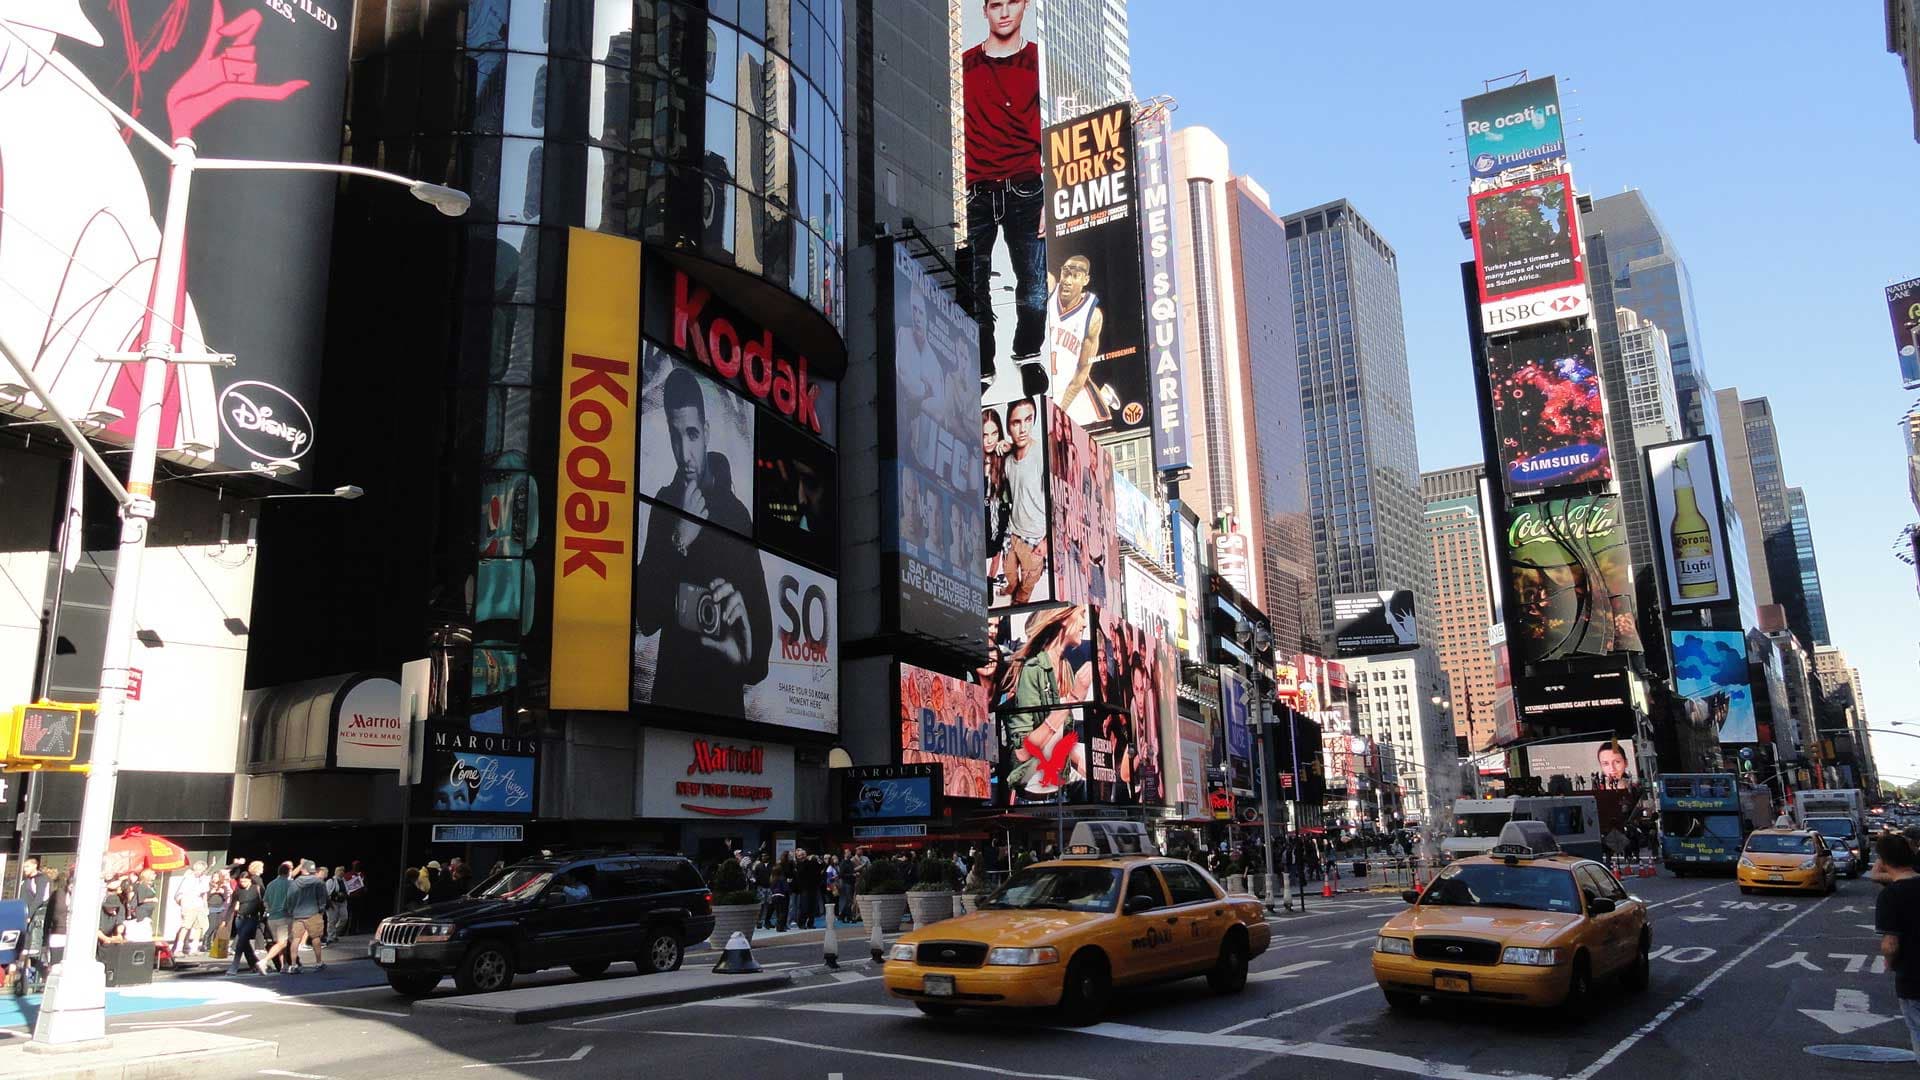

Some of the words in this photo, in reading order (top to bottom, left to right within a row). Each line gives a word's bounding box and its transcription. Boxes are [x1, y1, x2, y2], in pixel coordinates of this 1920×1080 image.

[1050, 109, 1123, 168] NEW
[1497, 141, 1562, 165] Prudential
[1052, 147, 1126, 190] YORK'S
[1053, 170, 1128, 221] GAME
[1137, 135, 1168, 258] TIMES
[1484, 262, 1508, 273] Turkey
[1529, 253, 1549, 263] times
[1485, 271, 1505, 281] many
[1505, 267, 1525, 276] acres
[1526, 264, 1535, 272] of
[1535, 257, 1571, 270] vineyards
[1495, 276, 1517, 287] South
[1887, 290, 1911, 302] LANE
[1488, 300, 1546, 326] HSBC
[674, 269, 822, 434] Kodak
[1151, 271, 1180, 430] SQUARE
[910, 412, 970, 493] UFC
[1162, 445, 1181, 456] NYC
[1521, 452, 1590, 473] SAMSUNG
[562, 353, 630, 581] Kodak
[1508, 503, 1617, 548] Coca-Cola
[1680, 559, 1711, 575] Light
[902, 568, 922, 590] LIVE
[924, 577, 937, 596] ON
[908, 559, 930, 581] SAT.
[931, 568, 971, 598] OCTOBER
[971, 589, 983, 605] 23
[778, 574, 828, 646] SO
[778, 682, 795, 695] SHARE
[815, 689, 830, 702] KODAK
[788, 694, 809, 707] MOMENT
[809, 698, 822, 709] HERE
[340, 731, 357, 739] NEW
[359, 731, 379, 740] YORK
[380, 733, 401, 742] MARQ
[435, 732, 537, 754] MARQUIS
[917, 707, 969, 759] Bank
[972, 721, 989, 761] of
[687, 737, 765, 776] Marriott
[1092, 751, 1107, 768] EAGLE
[450, 758, 480, 788] Come
[476, 756, 499, 791] Fly
[497, 769, 530, 807] Away
[847, 765, 932, 779] MARQUIS
[859, 784, 884, 804] Come
[1677, 800, 1713, 809] CitySights
[1672, 900, 1798, 913] ONLY
